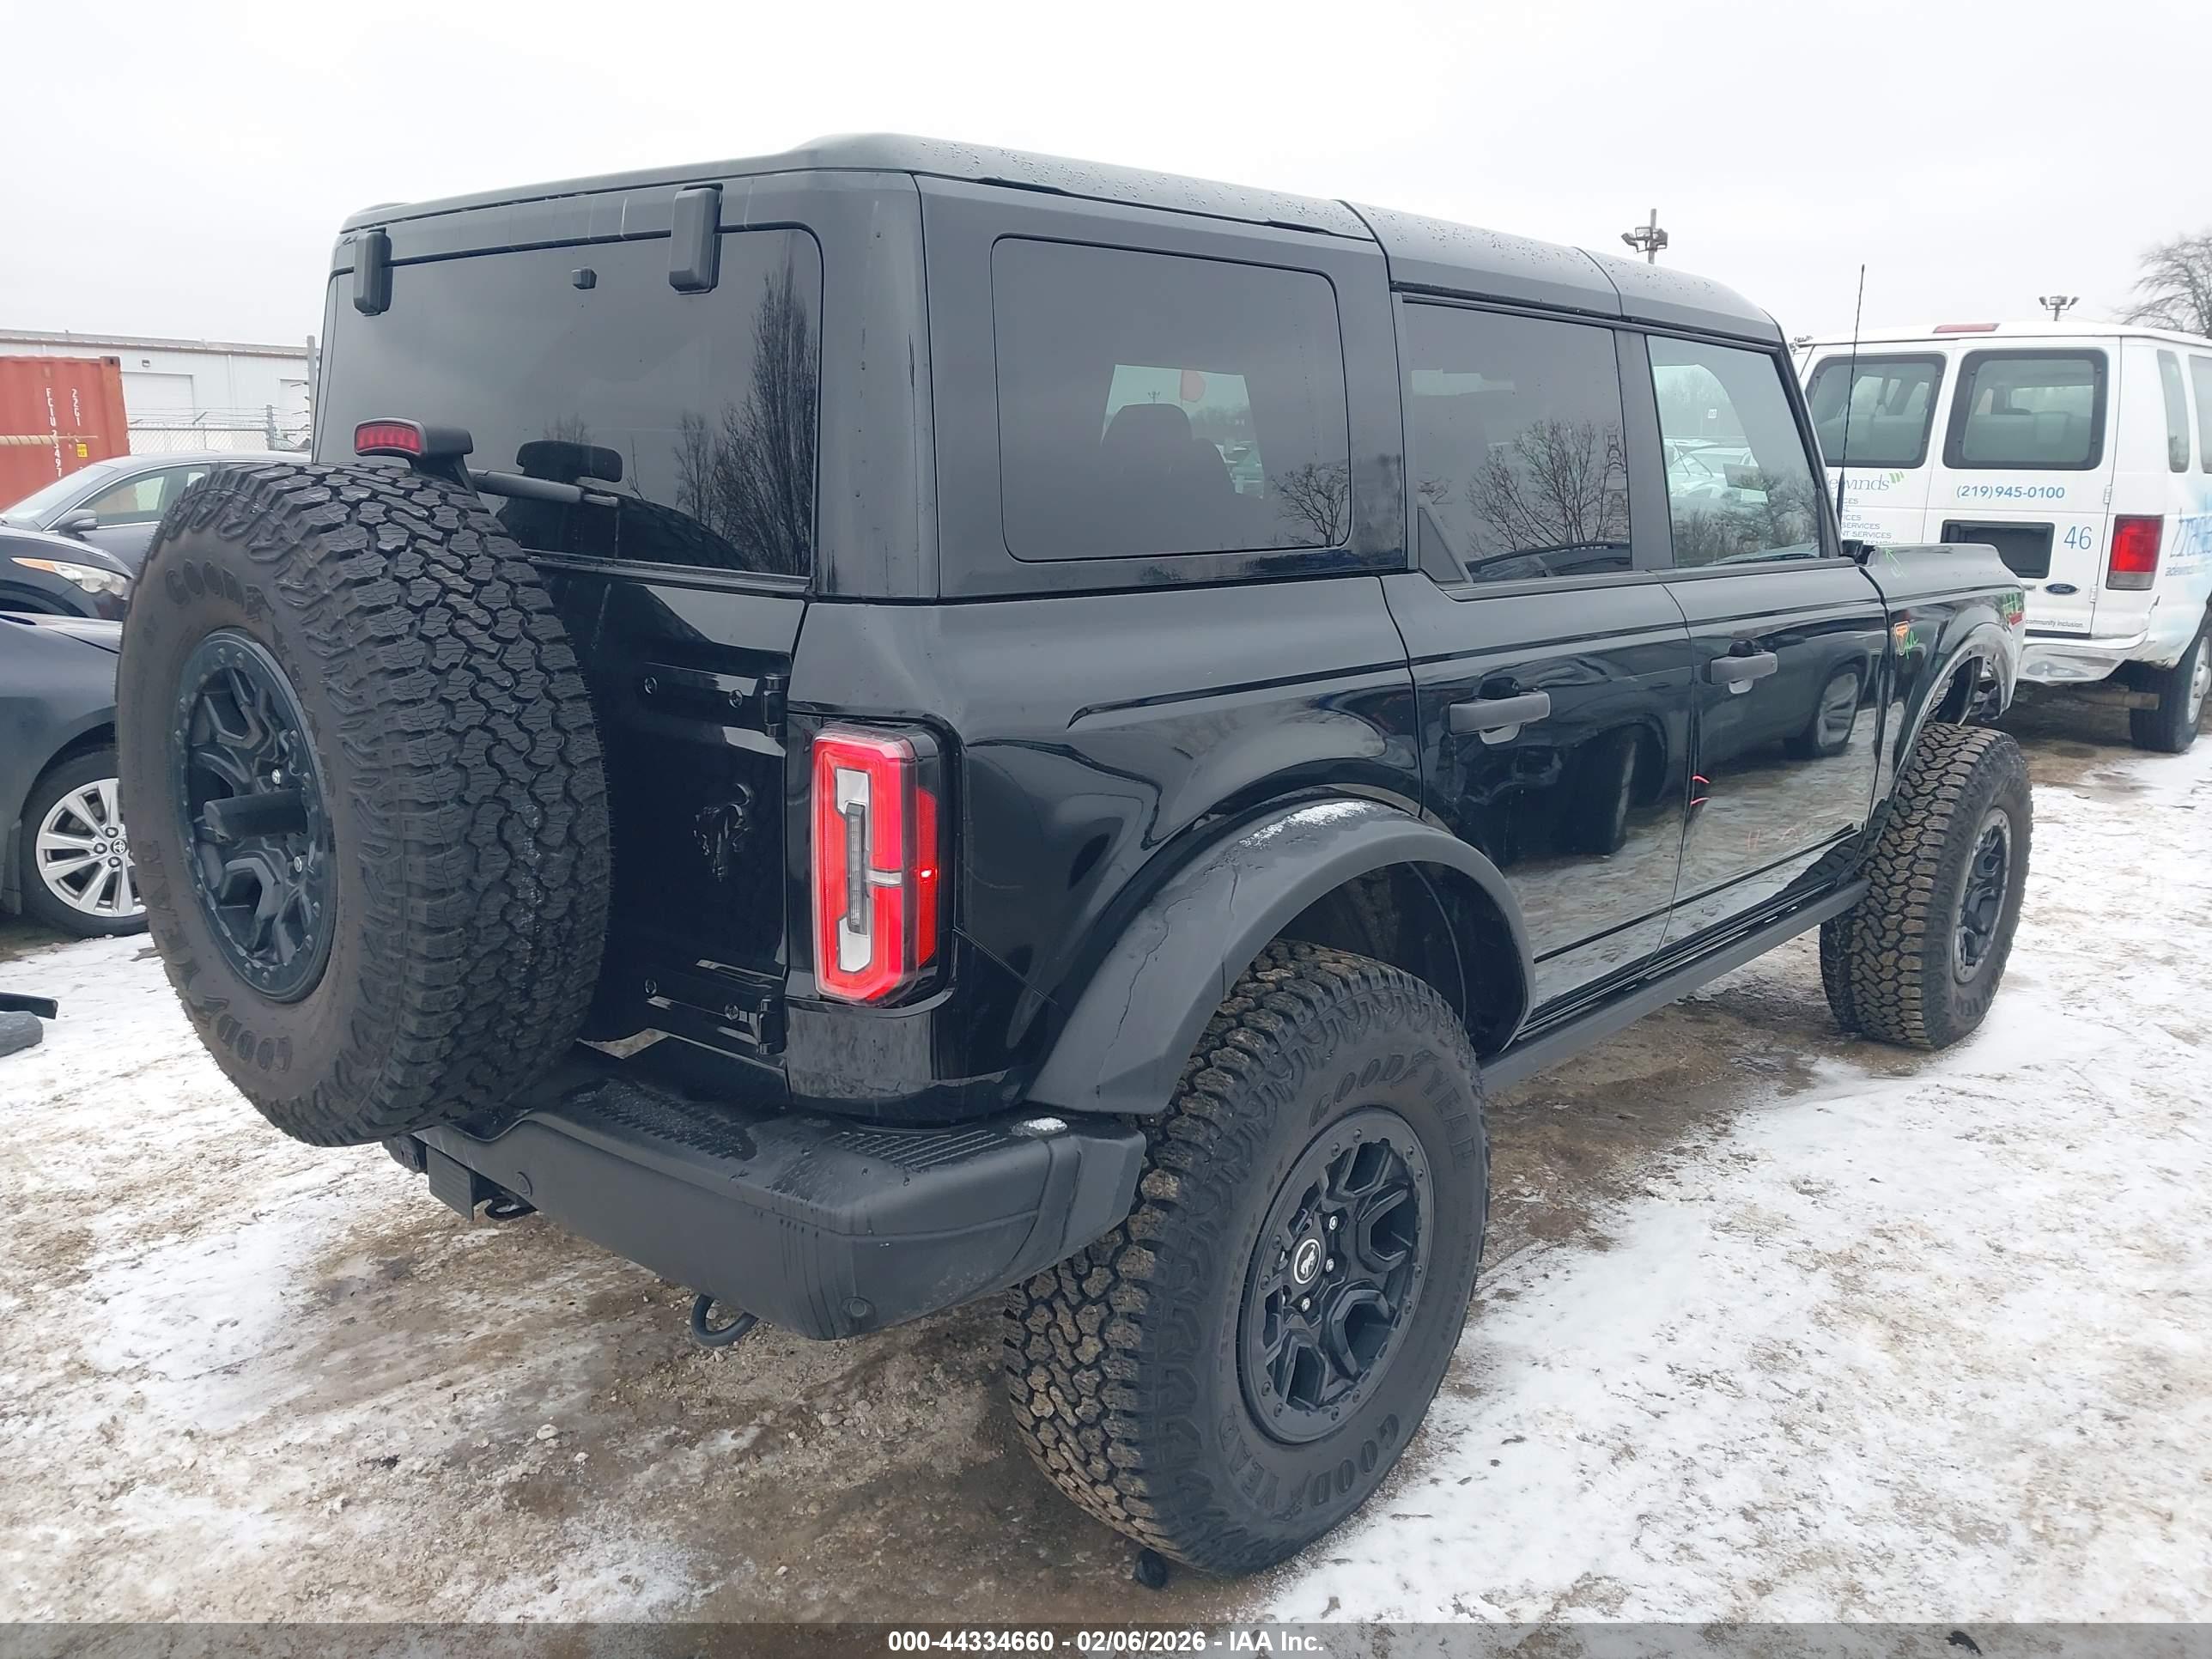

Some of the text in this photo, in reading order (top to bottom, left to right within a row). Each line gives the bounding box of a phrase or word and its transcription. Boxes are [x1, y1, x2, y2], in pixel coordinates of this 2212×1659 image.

[46, 387, 57, 427] FCIU
[71, 388, 81, 427] 22G1
[1956, 485, 2065, 499] (219)945-0100
[2063, 526, 2093, 550] 46
